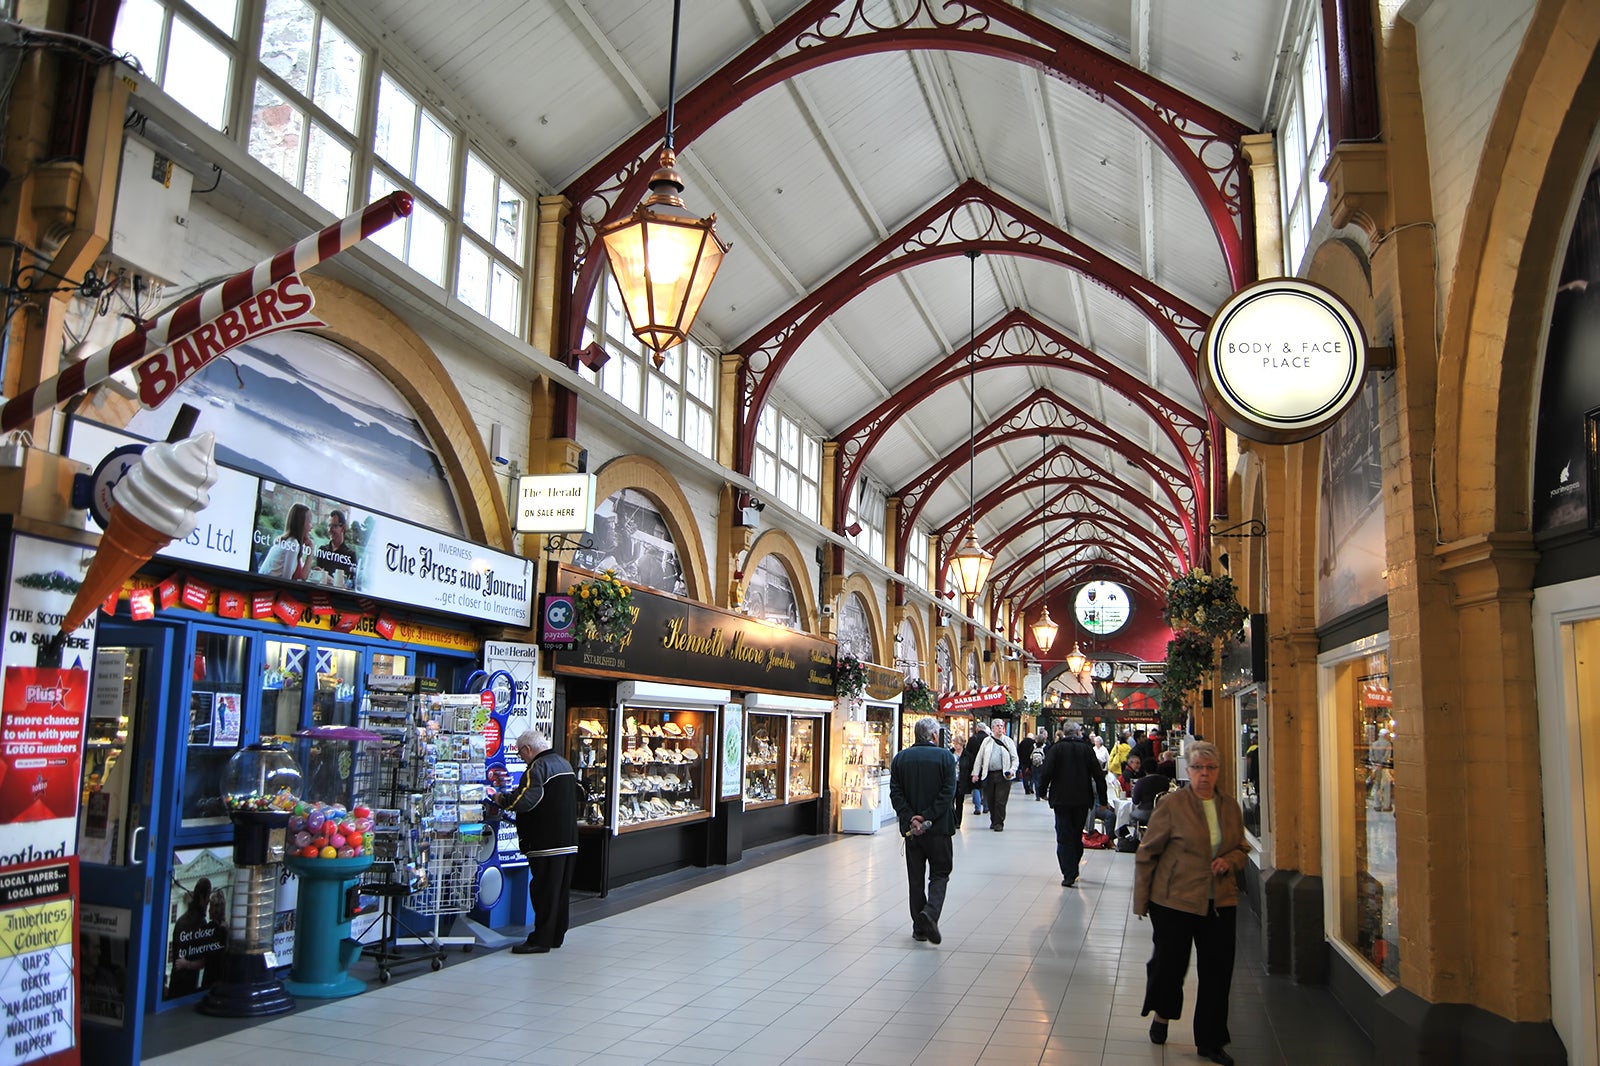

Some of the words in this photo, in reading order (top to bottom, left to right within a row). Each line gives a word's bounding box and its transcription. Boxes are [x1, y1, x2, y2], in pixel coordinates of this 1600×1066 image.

[137, 275, 312, 408] BARBERS
[1228, 342, 1272, 353] BODY
[1282, 342, 1292, 353] &
[1302, 341, 1342, 353] FACE
[1262, 357, 1311, 368] PLACE
[522, 488, 541, 498] The
[548, 487, 581, 497] Herald
[524, 509, 535, 517] ON
[537, 508, 554, 517] SALE
[556, 508, 575, 517] HERE
[206, 523, 237, 555] Ltd.
[253, 529, 271, 546] Get
[273, 536, 300, 553] closer
[302, 543, 312, 556] to
[438, 542, 473, 561] INVERNESS
[386, 542, 416, 576] The
[419, 546, 458, 586] Press
[460, 569, 482, 592] and
[482, 568, 527, 602] Journal
[9, 608, 33, 622] THE
[458, 593, 481, 609] closer
[483, 600, 492, 612] to
[493, 603, 527, 619] Inverness
[10, 630, 27, 643] ON
[400, 623, 414, 639] The
[416, 625, 452, 643] Inverness
[663, 617, 727, 658] Kenneth
[730, 630, 764, 664] Moore
[489, 645, 505, 656] The
[509, 646, 536, 658] Herald
[583, 653, 617, 667] ESTABLISHED
[537, 687, 545, 698] THE
[953, 695, 982, 705] BARBER
[983, 692, 1003, 701] SHOP
[6, 715, 13, 725] 5
[14, 716, 42, 726] more
[44, 714, 79, 726] chances
[1051, 709, 1082, 717] Victorian
[1128, 709, 1154, 718] Market
[4, 729, 15, 740] to
[18, 728, 36, 740] win
[38, 728, 58, 740] with
[59, 730, 79, 741] your
[6, 744, 36, 755] Lotto
[36, 743, 76, 754] numbers
[0, 841, 65, 867] cotland
[0, 875, 26, 889] LOCAL
[28, 870, 67, 884] PAPERS...
[8, 886, 34, 900] LOCAL
[36, 882, 59, 895] NEWS
[4, 908, 67, 932] Inverness
[15, 927, 58, 950] Courier
[179, 930, 193, 942] Get
[194, 926, 215, 939] closer
[178, 946, 187, 958] to
[22, 952, 50, 972] OAP'S
[21, 971, 50, 992] DEATH
[22, 986, 68, 1013] ACCIDENT
[7, 1012, 50, 1038] WAITING
[52, 1008, 64, 1024] TO
